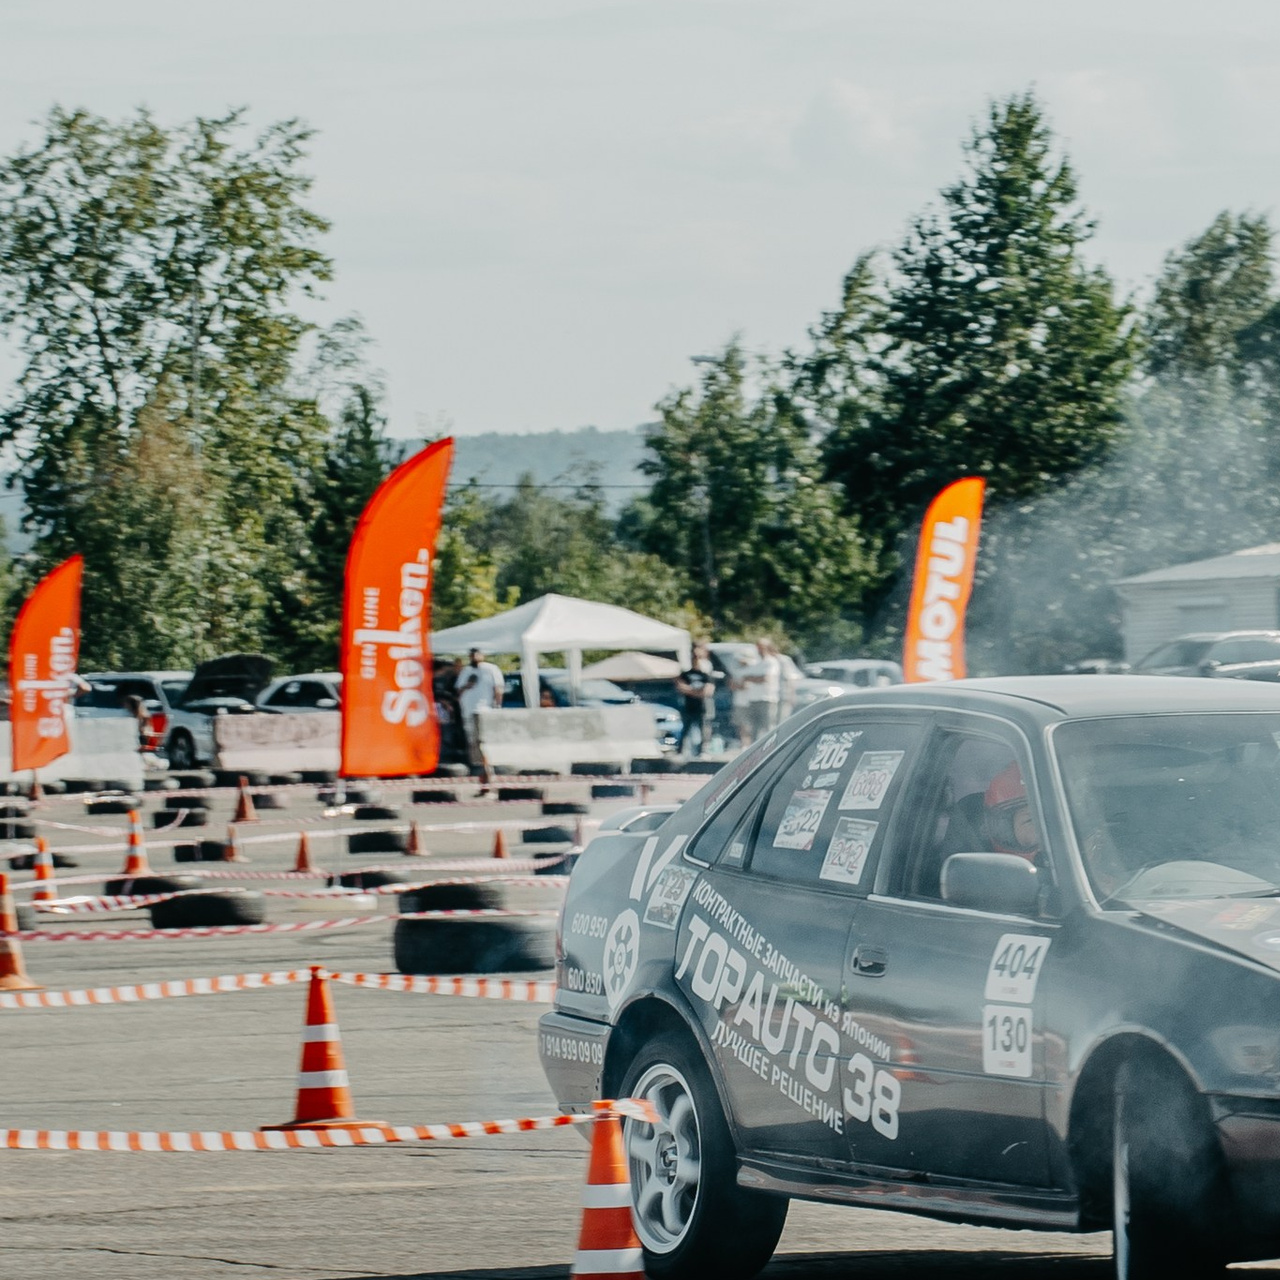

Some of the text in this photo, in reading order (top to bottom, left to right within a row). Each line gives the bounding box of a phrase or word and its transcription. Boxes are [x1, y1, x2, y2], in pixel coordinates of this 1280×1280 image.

[915, 516, 969, 681] MOTUL
[808, 743, 851, 771] 206
[571, 912, 608, 939] 600 950
[692, 878, 766, 960] КОНТРАКТНЫЕ
[761, 943, 823, 1010] ЗАПЧАСТИ
[568, 967, 602, 995] 600 850
[993, 942, 1043, 981] 404
[674, 913, 901, 1140] TOPAUTO 38
[988, 1014, 1027, 1054] 130
[546, 1035, 561, 1059] 914
[561, 1037, 578, 1061] 939
[578, 1040, 591, 1064] 09
[591, 1042, 603, 1066] 09
[711, 1020, 844, 1135] ЛУЧШЕЕ РЕШЕНИЕ
